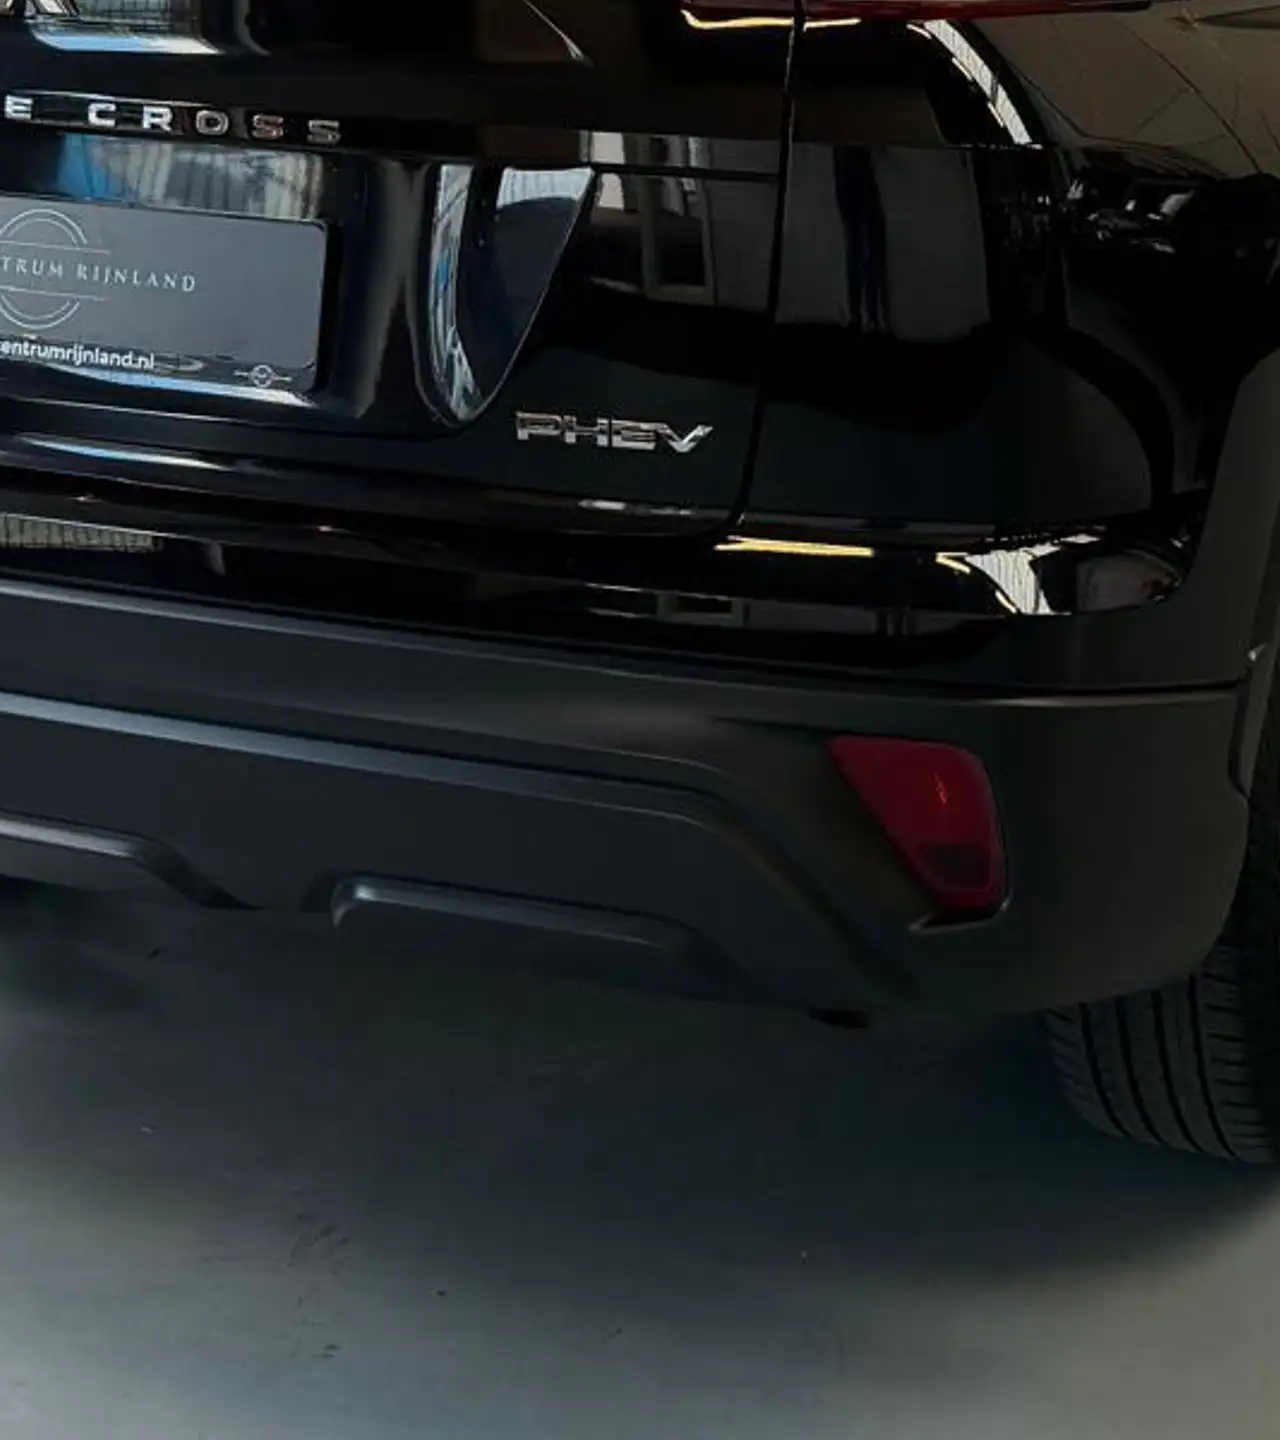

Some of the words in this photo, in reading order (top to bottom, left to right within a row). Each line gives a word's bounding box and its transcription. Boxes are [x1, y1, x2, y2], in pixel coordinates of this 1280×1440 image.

[86, 101, 342, 145] CROSS
[75, 260, 197, 293] RIJNLAND
[516, 411, 714, 453] PHEV
